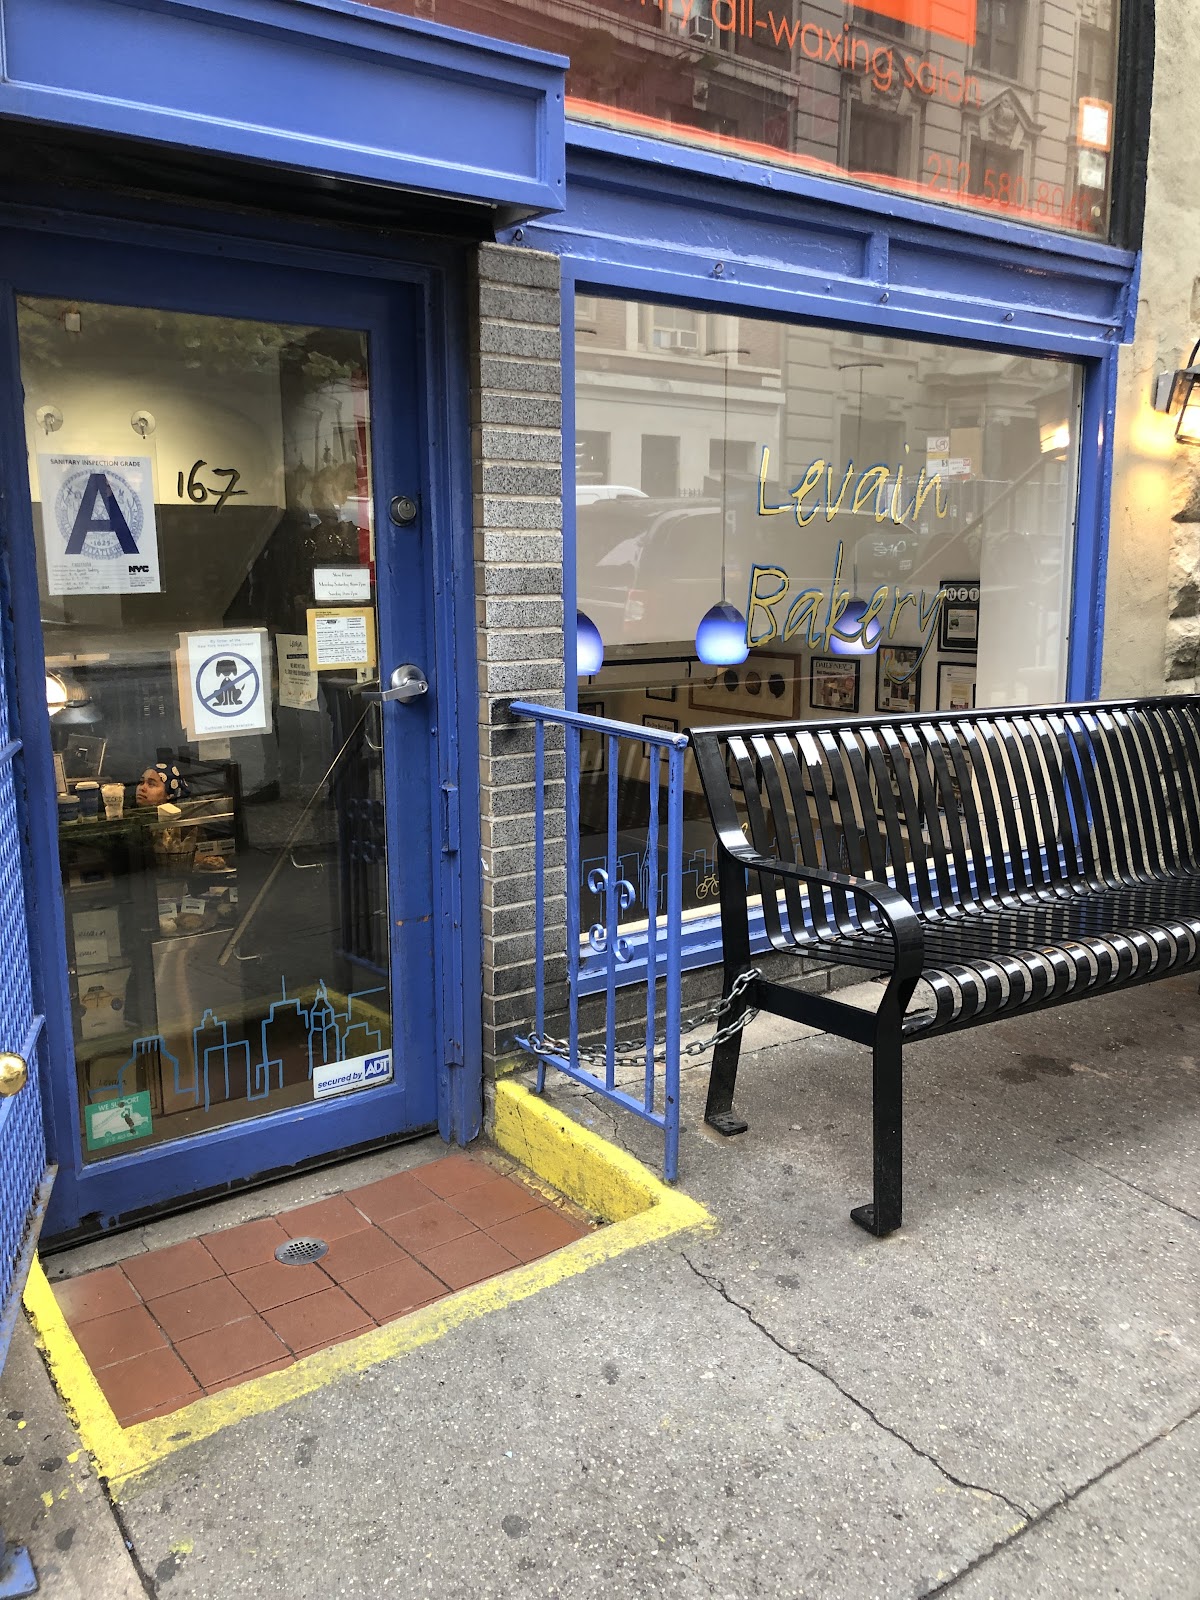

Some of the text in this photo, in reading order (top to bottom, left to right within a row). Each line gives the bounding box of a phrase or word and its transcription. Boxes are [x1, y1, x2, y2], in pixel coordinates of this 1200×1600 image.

[711, 0, 981, 110] all-waxing salon
[82, 459, 119, 467] INSPECTION
[177, 459, 249, 515] 167
[757, 441, 948, 528] Levain
[64, 473, 140, 555] A
[128, 565, 149, 573] NYC
[744, 539, 948, 685] Bakery
[317, 1059, 389, 1089] secured by ADT
[98, 1096, 140, 1112] WE SUORT
